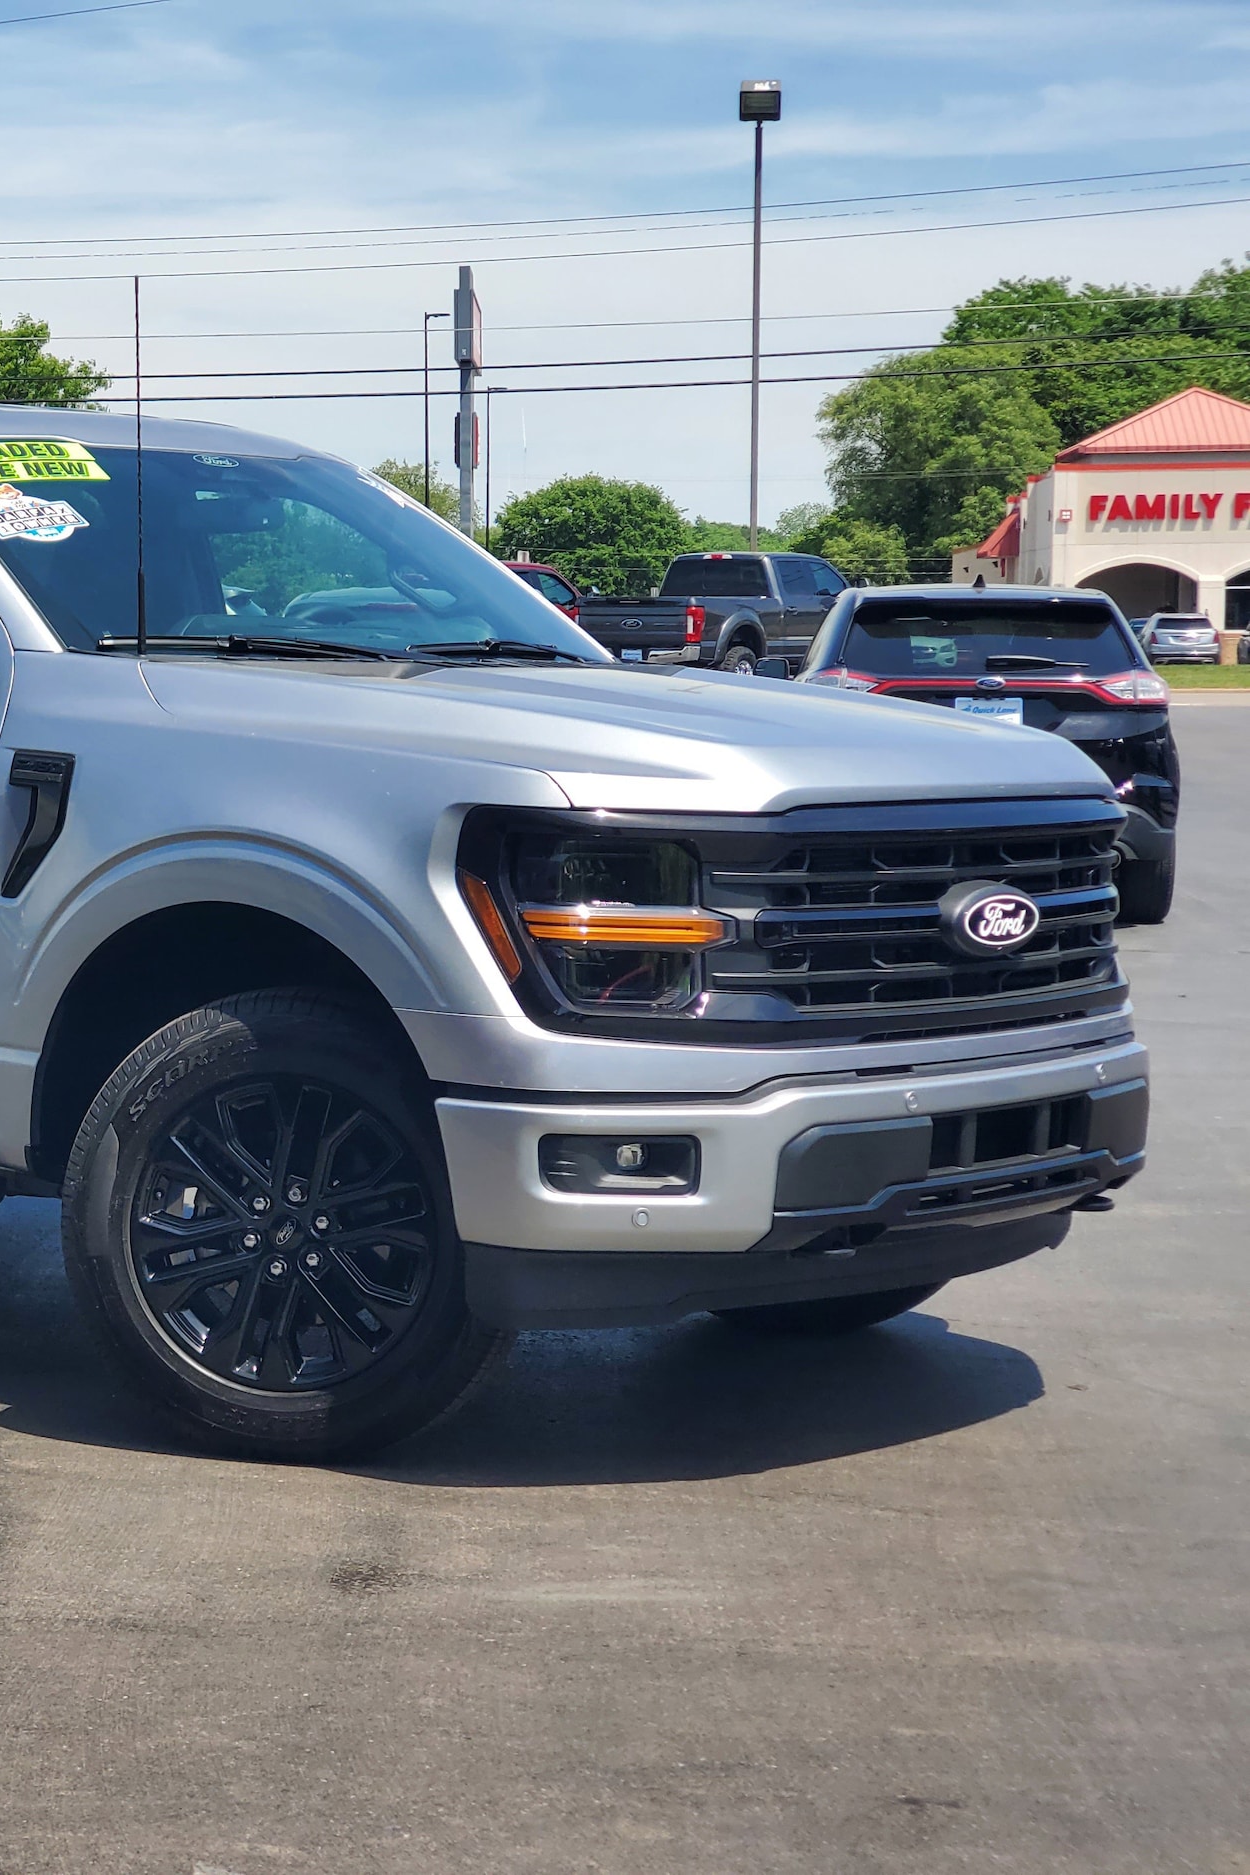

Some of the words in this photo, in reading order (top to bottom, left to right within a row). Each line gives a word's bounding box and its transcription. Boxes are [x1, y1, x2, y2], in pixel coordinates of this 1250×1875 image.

[21, 461, 89, 478] NEW
[1089, 493, 1224, 521] FAMILY
[10, 514, 81, 532] OWNER
[972, 706, 995, 714] Quick
[979, 902, 1026, 937] Ford
